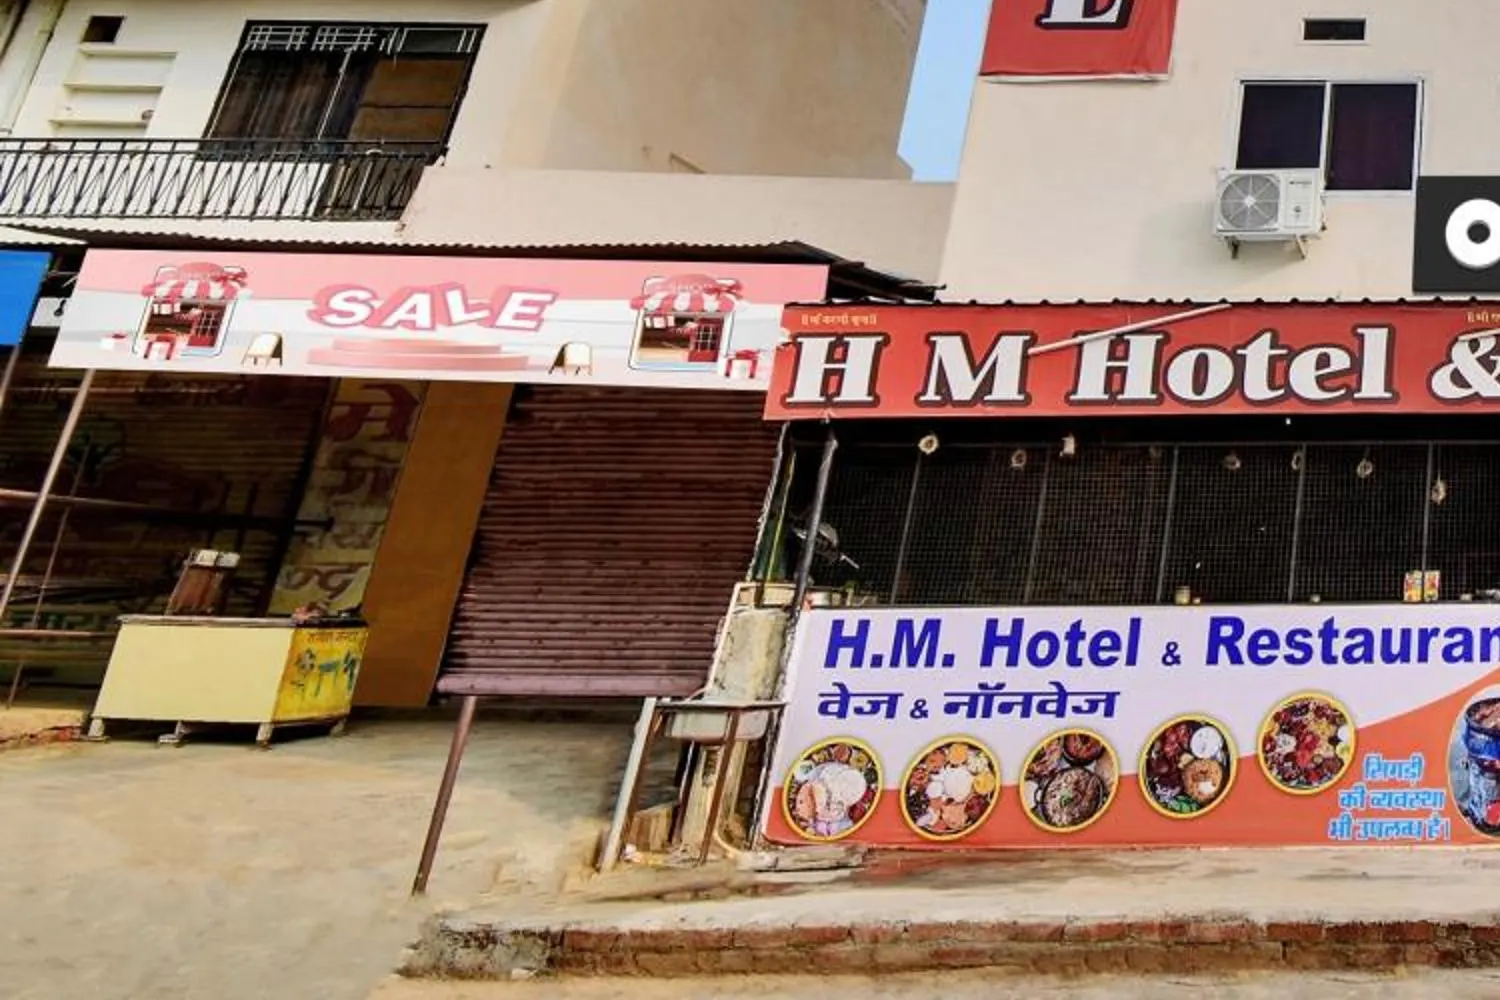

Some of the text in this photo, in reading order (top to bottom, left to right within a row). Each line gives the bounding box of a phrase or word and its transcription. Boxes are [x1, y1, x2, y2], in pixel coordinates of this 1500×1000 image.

[312, 282, 558, 333] SALE
[1067, 325, 1397, 404] Hotel
[822, 616, 956, 670] H.M.
[977, 616, 1141, 669] Hotel
[1160, 639, 1183, 668] &
[816, 679, 1122, 721] वेज & नॉनवेज
[1339, 782, 1446, 810] की व्यवस्था
[1328, 811, 1353, 840] भी
